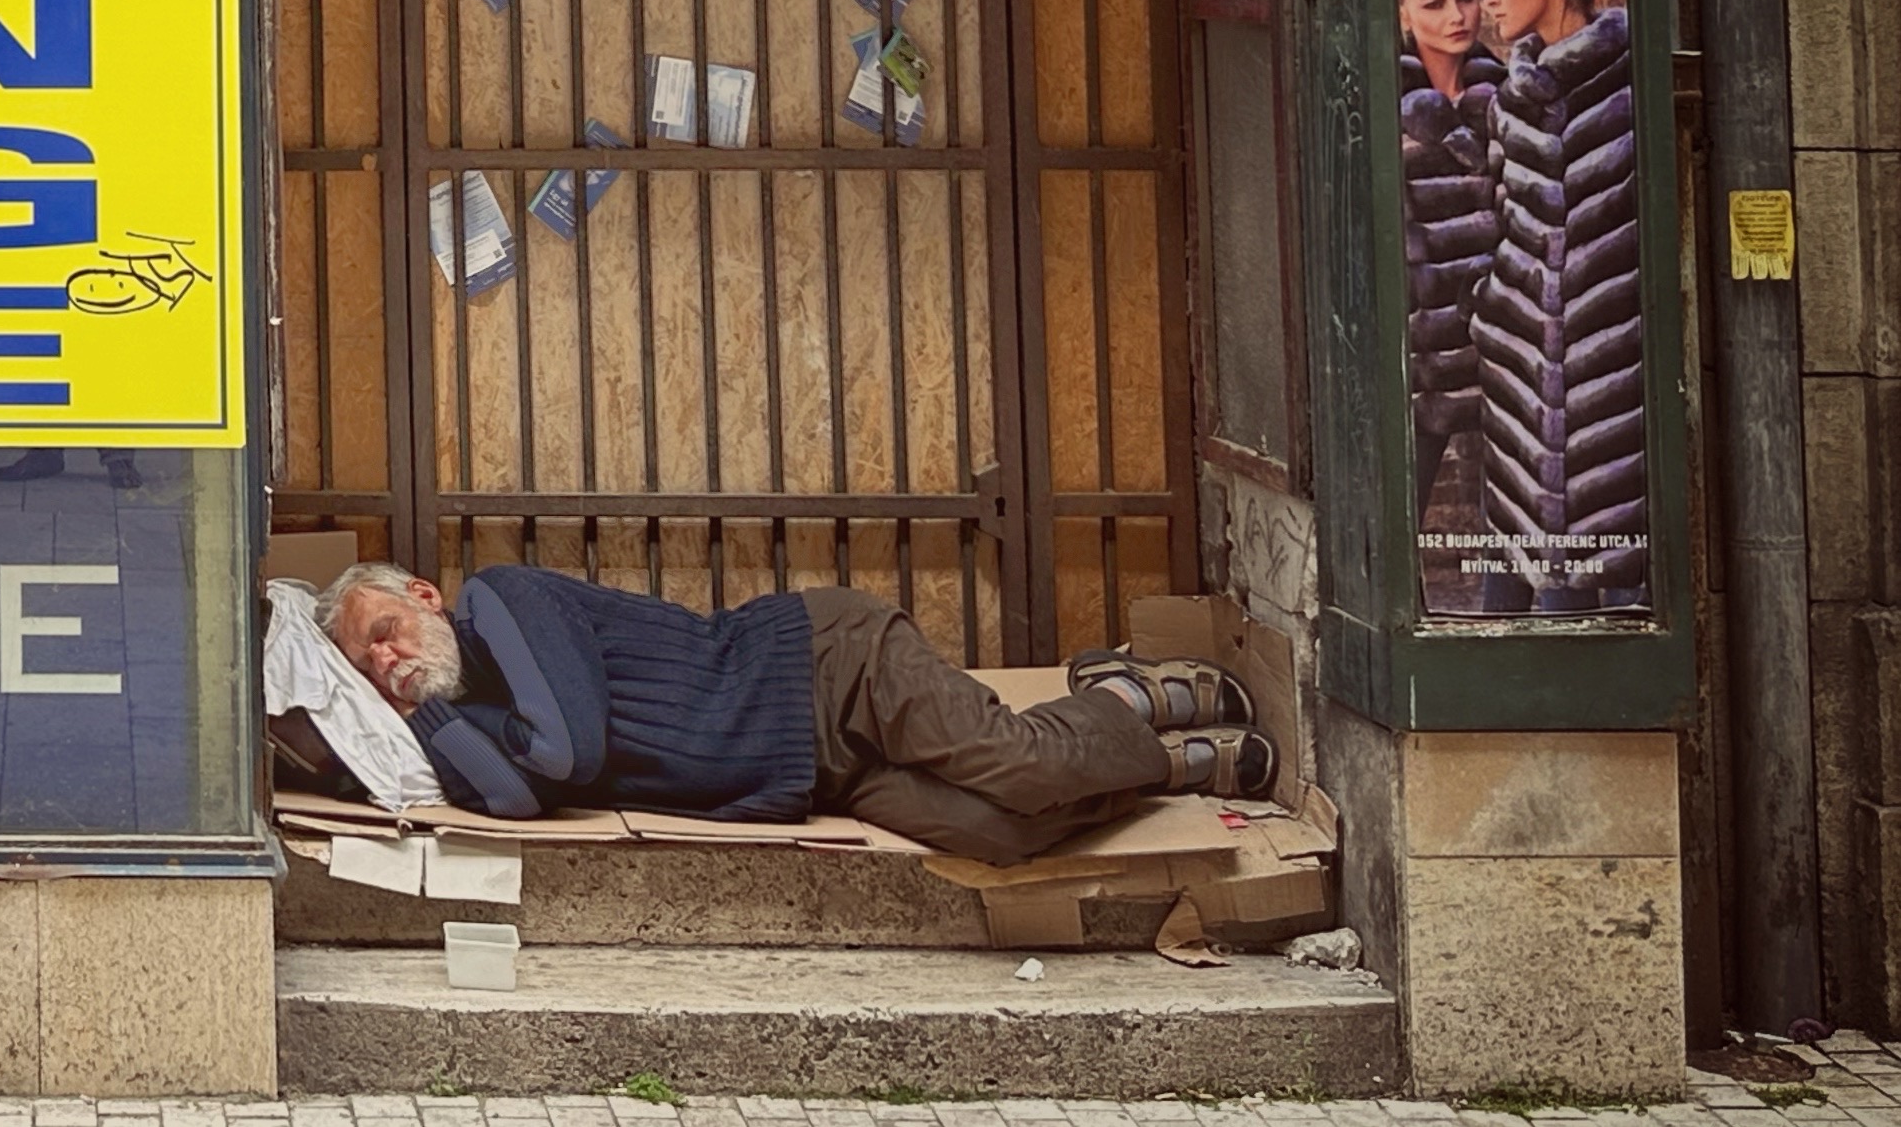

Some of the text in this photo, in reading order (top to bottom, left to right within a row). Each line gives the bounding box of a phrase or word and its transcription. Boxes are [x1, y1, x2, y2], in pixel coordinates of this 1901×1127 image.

[1446, 534, 1511, 548] BUDAPEST
[1548, 534, 1597, 548] FERENC
[1599, 534, 1631, 548] UTCA
